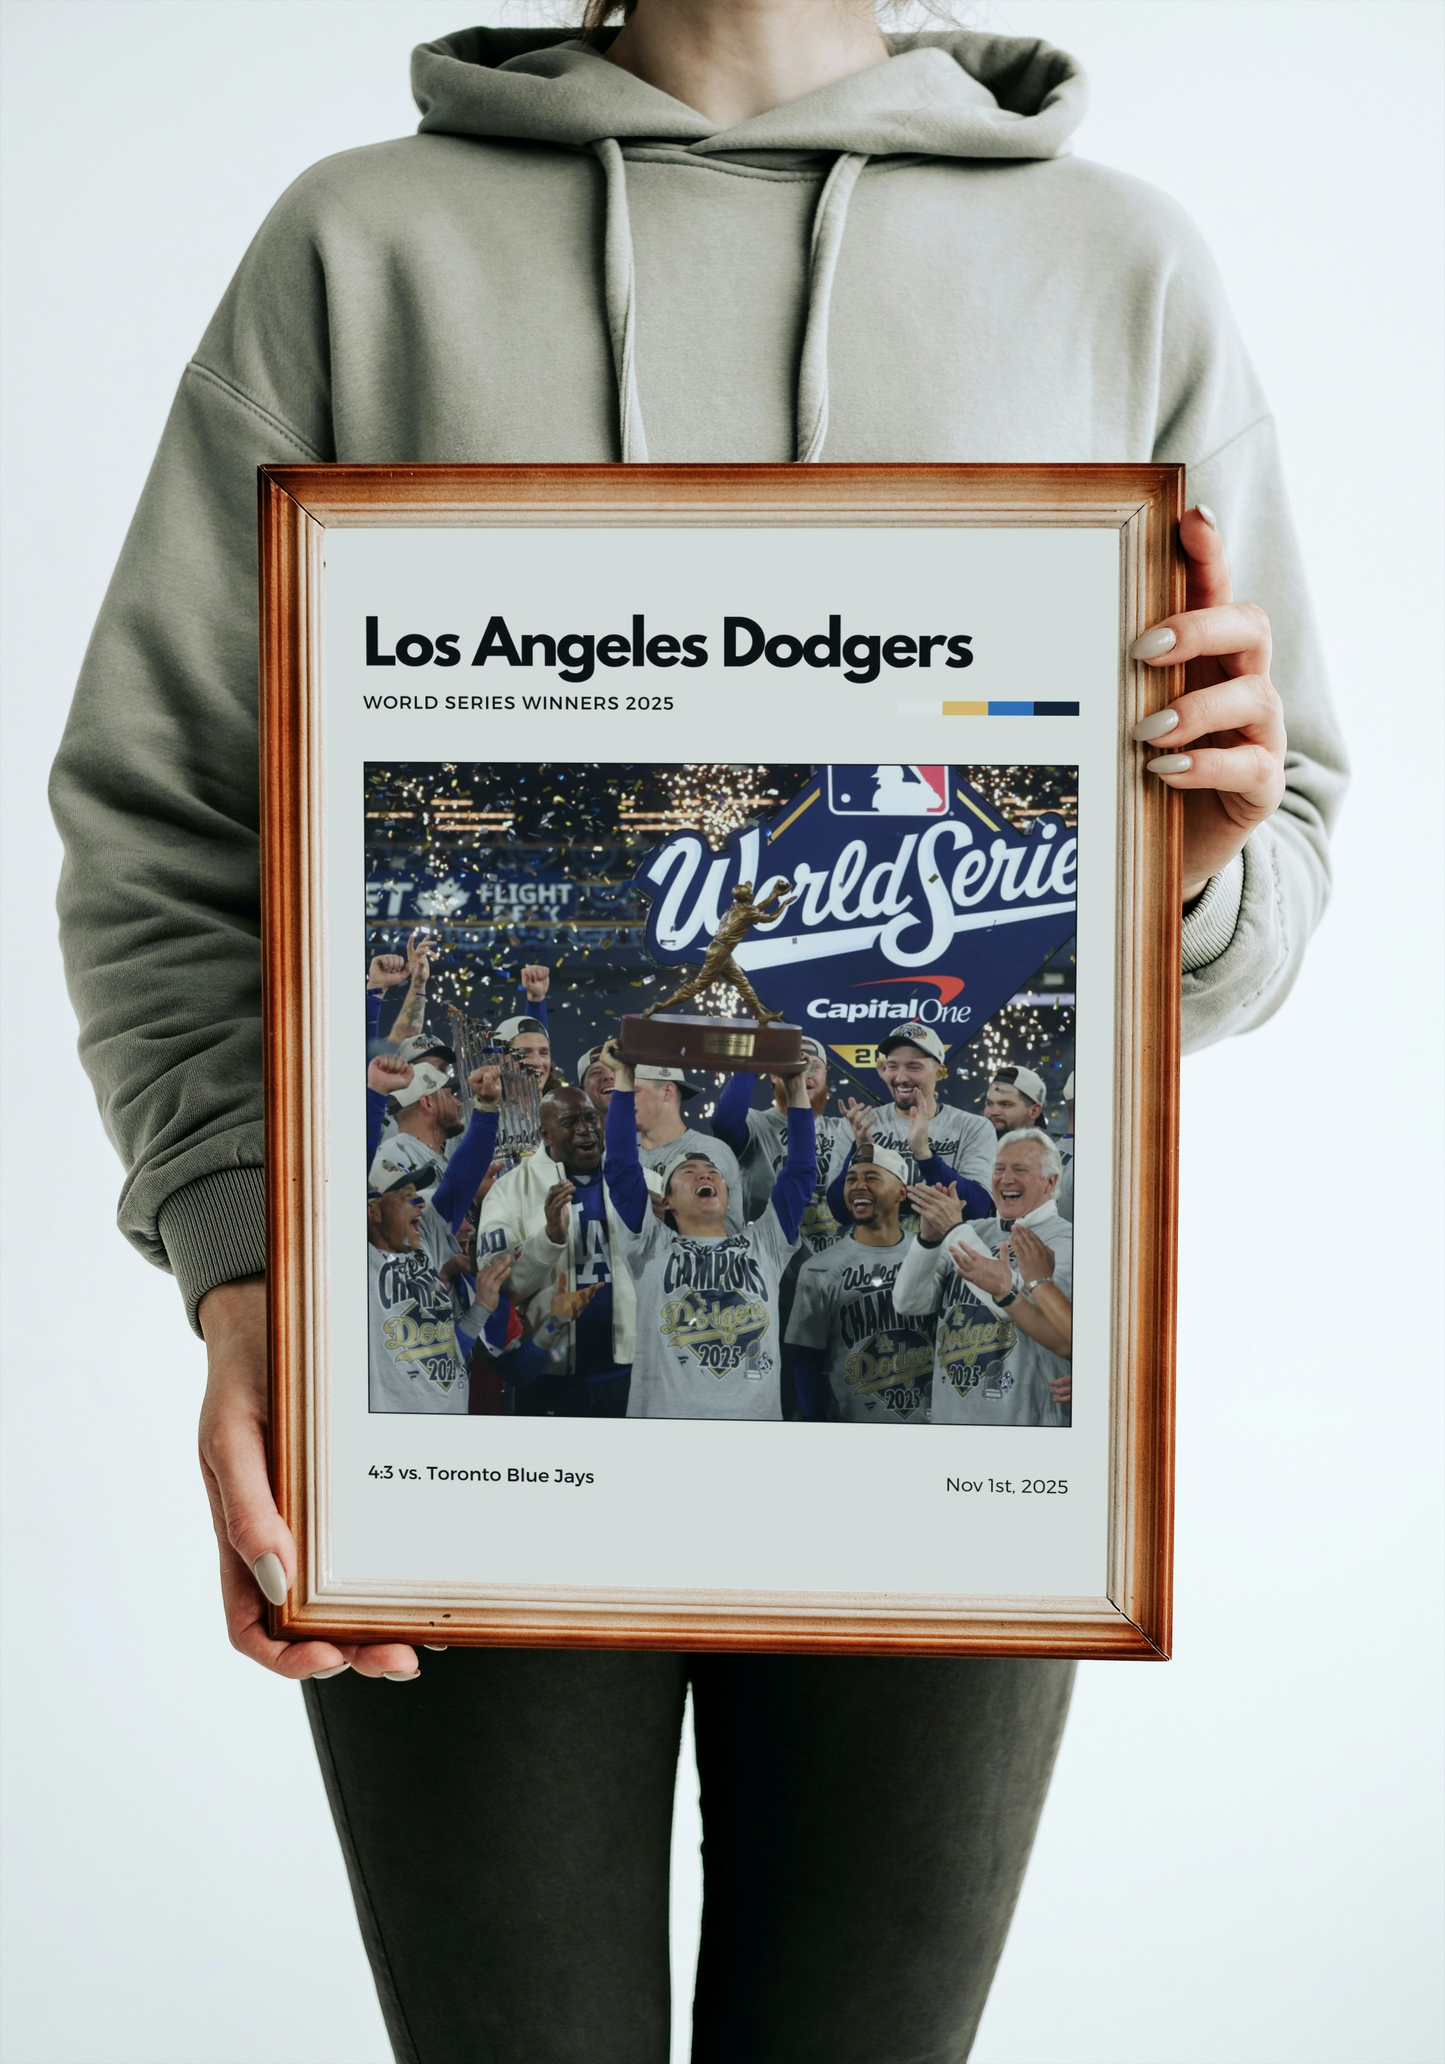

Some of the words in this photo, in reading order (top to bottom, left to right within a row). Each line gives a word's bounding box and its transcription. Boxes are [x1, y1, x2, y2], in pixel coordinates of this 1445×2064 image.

[365, 615, 462, 668] Los
[470, 613, 709, 684] Angeles
[723, 614, 974, 685] Dodgers
[362, 695, 439, 710] WORLD
[444, 695, 516, 710] SERIES
[521, 695, 619, 711] WINNERS
[625, 696, 674, 711] 2025
[480, 883, 573, 904] FLIGHT
[648, 828, 918, 951] World
[477, 1227, 508, 1258] AD
[842, 1262, 897, 1291] Wold
[660, 1299, 768, 1346] Dodgers
[699, 1345, 741, 1369] 2025
[843, 1342, 935, 1389] Dodger
[950, 1364, 981, 1387] 2025
[885, 1389, 920, 1410] 2025
[368, 1464, 394, 1480] 4:3
[398, 1468, 422, 1481] vs.
[425, 1466, 502, 1482] Toronto
[507, 1467, 550, 1483] Blue
[553, 1468, 595, 1488] Jays
[946, 1477, 984, 1493] Nov
[987, 1478, 1016, 1495] 1st,
[1021, 1479, 1069, 1495] 2025
